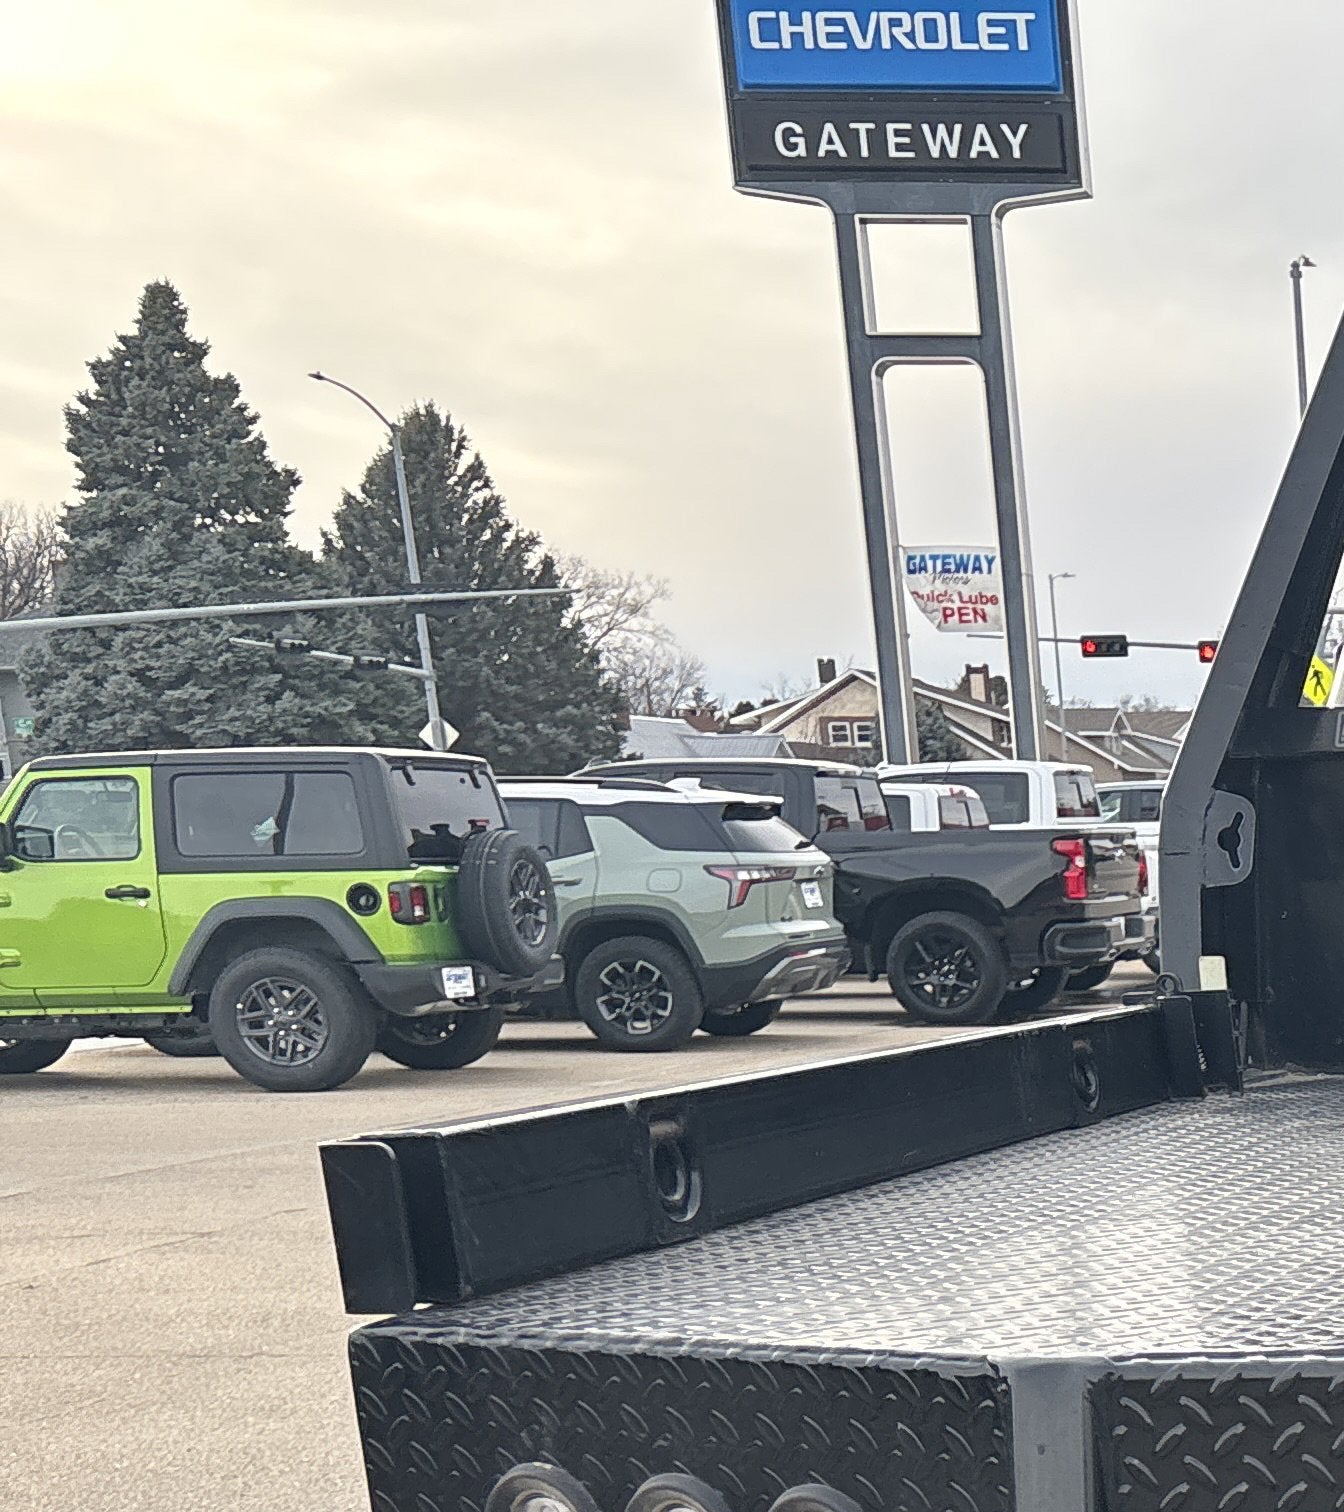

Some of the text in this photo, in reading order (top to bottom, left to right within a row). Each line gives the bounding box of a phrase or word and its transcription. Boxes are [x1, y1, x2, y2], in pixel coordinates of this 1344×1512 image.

[748, 11, 1036, 51] CHEVROLET
[773, 120, 1030, 160] GATEWAY
[906, 553, 997, 575] GATEWAY
[957, 590, 999, 605] Lube
[941, 606, 988, 624] PEN
